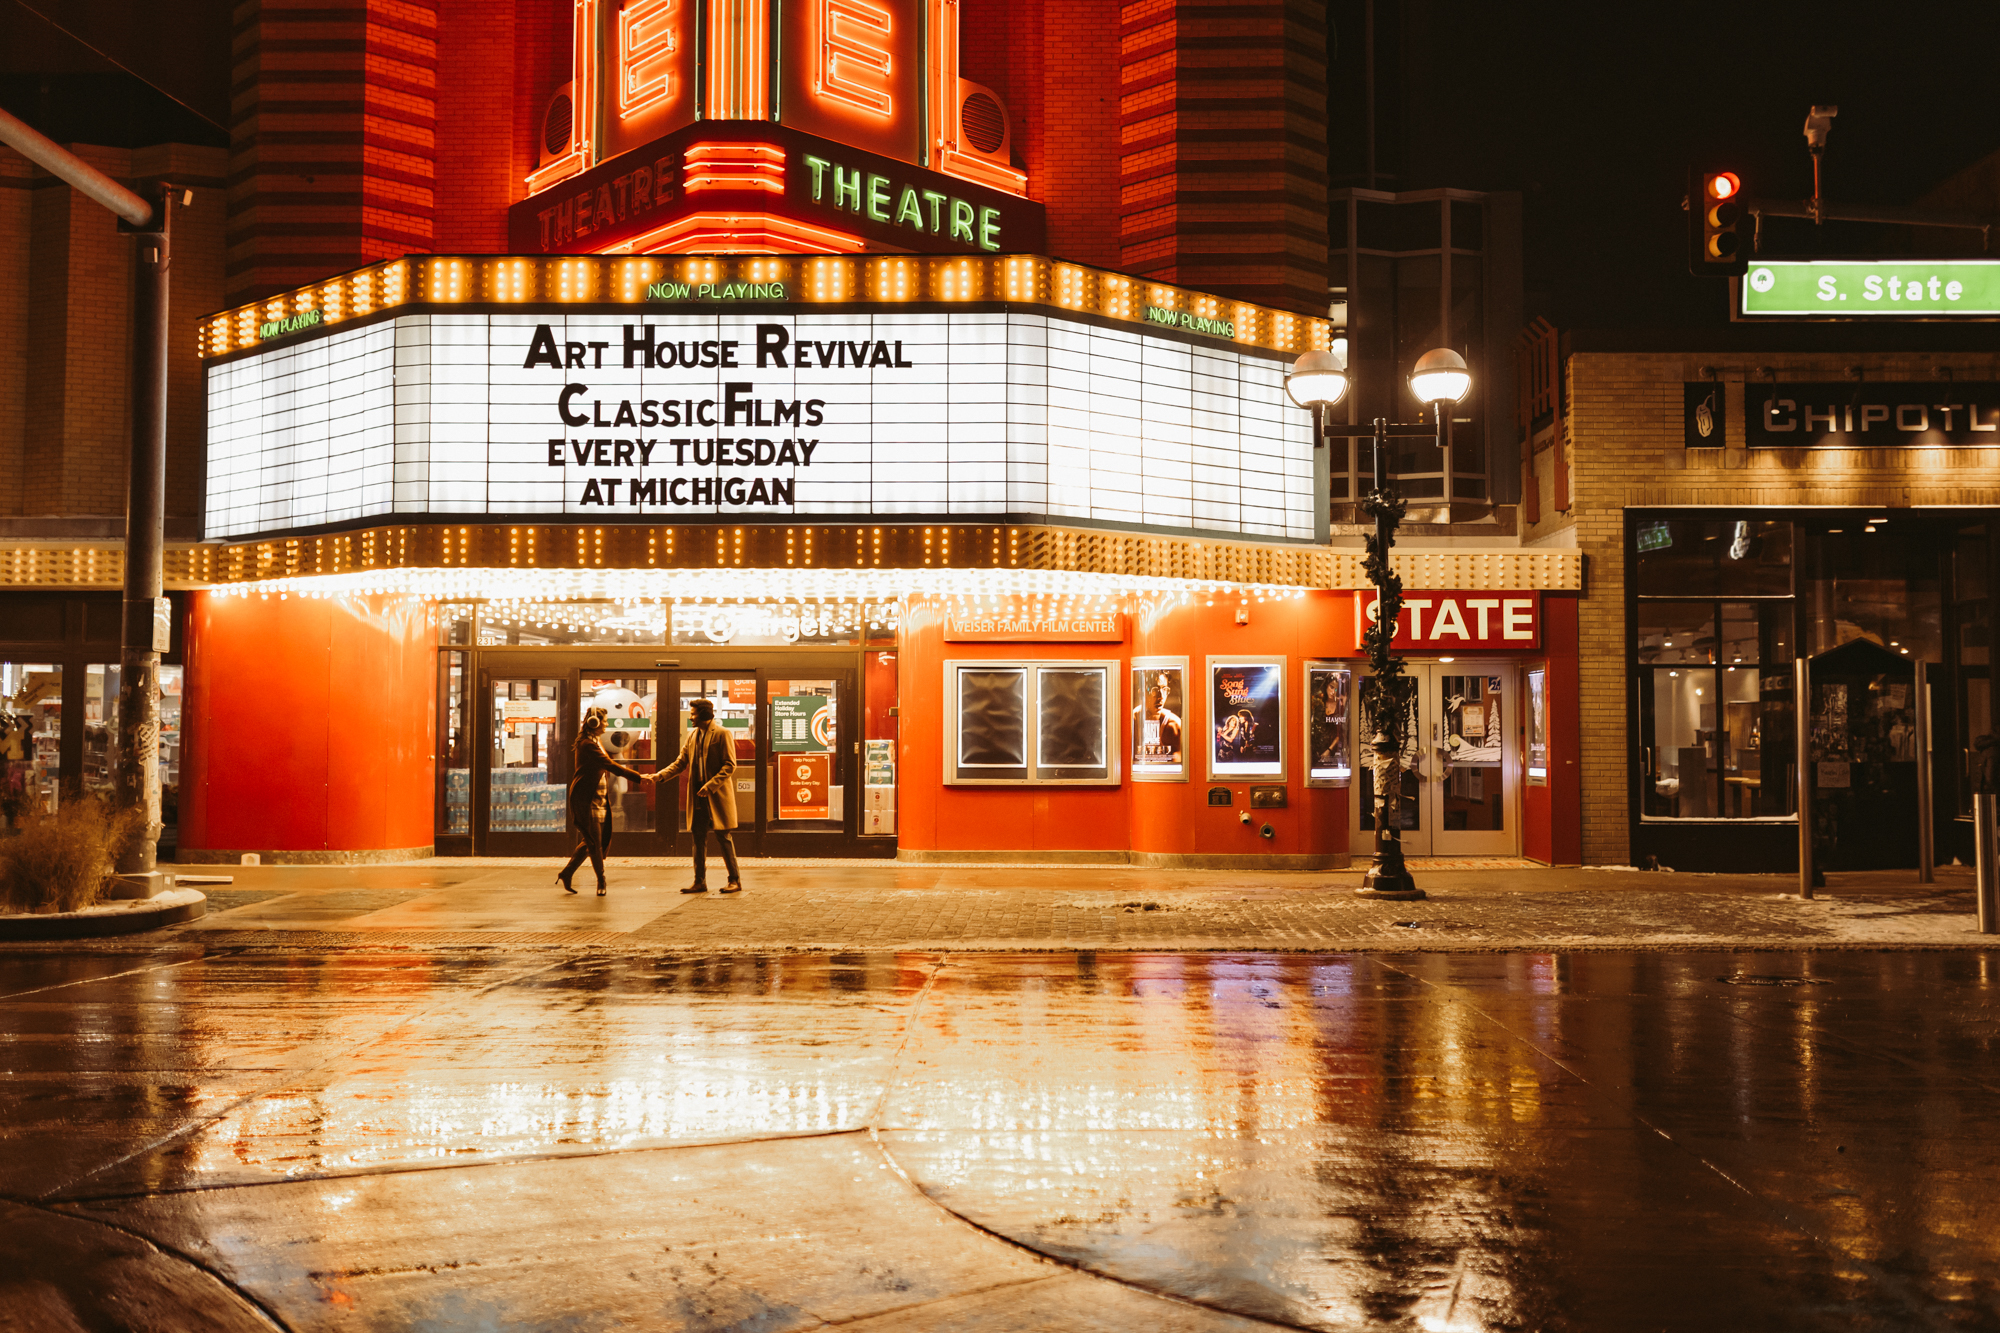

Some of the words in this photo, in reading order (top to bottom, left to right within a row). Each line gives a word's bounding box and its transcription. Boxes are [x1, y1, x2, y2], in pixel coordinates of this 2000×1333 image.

[537, 154, 675, 252] THEATRE
[803, 153, 1000, 252] THEATRE
[648, 283, 691, 299] NOW
[698, 282, 784, 299] PLAYING
[1816, 275, 1847, 301] S.
[1862, 275, 1963, 301] State
[260, 321, 280, 338] NOW
[280, 309, 320, 333] PLAYING
[1149, 306, 1178, 325] NOW
[1181, 313, 1236, 337] PLAYING
[548, 439, 657, 467] EVERY
[670, 439, 819, 467] TUESDAY
[580, 478, 622, 506] AT
[630, 478, 794, 506] MICHIGAN
[953, 620, 995, 632] WEISER
[997, 620, 1040, 632] FAMILY
[1042, 620, 1069, 632] FILM
[1071, 620, 1116, 632] CENTER
[477, 637, 493, 645] 231
[1220, 679, 1244, 690] Song
[1224, 687, 1249, 698] Sung
[1229, 695, 1255, 705] Blue
